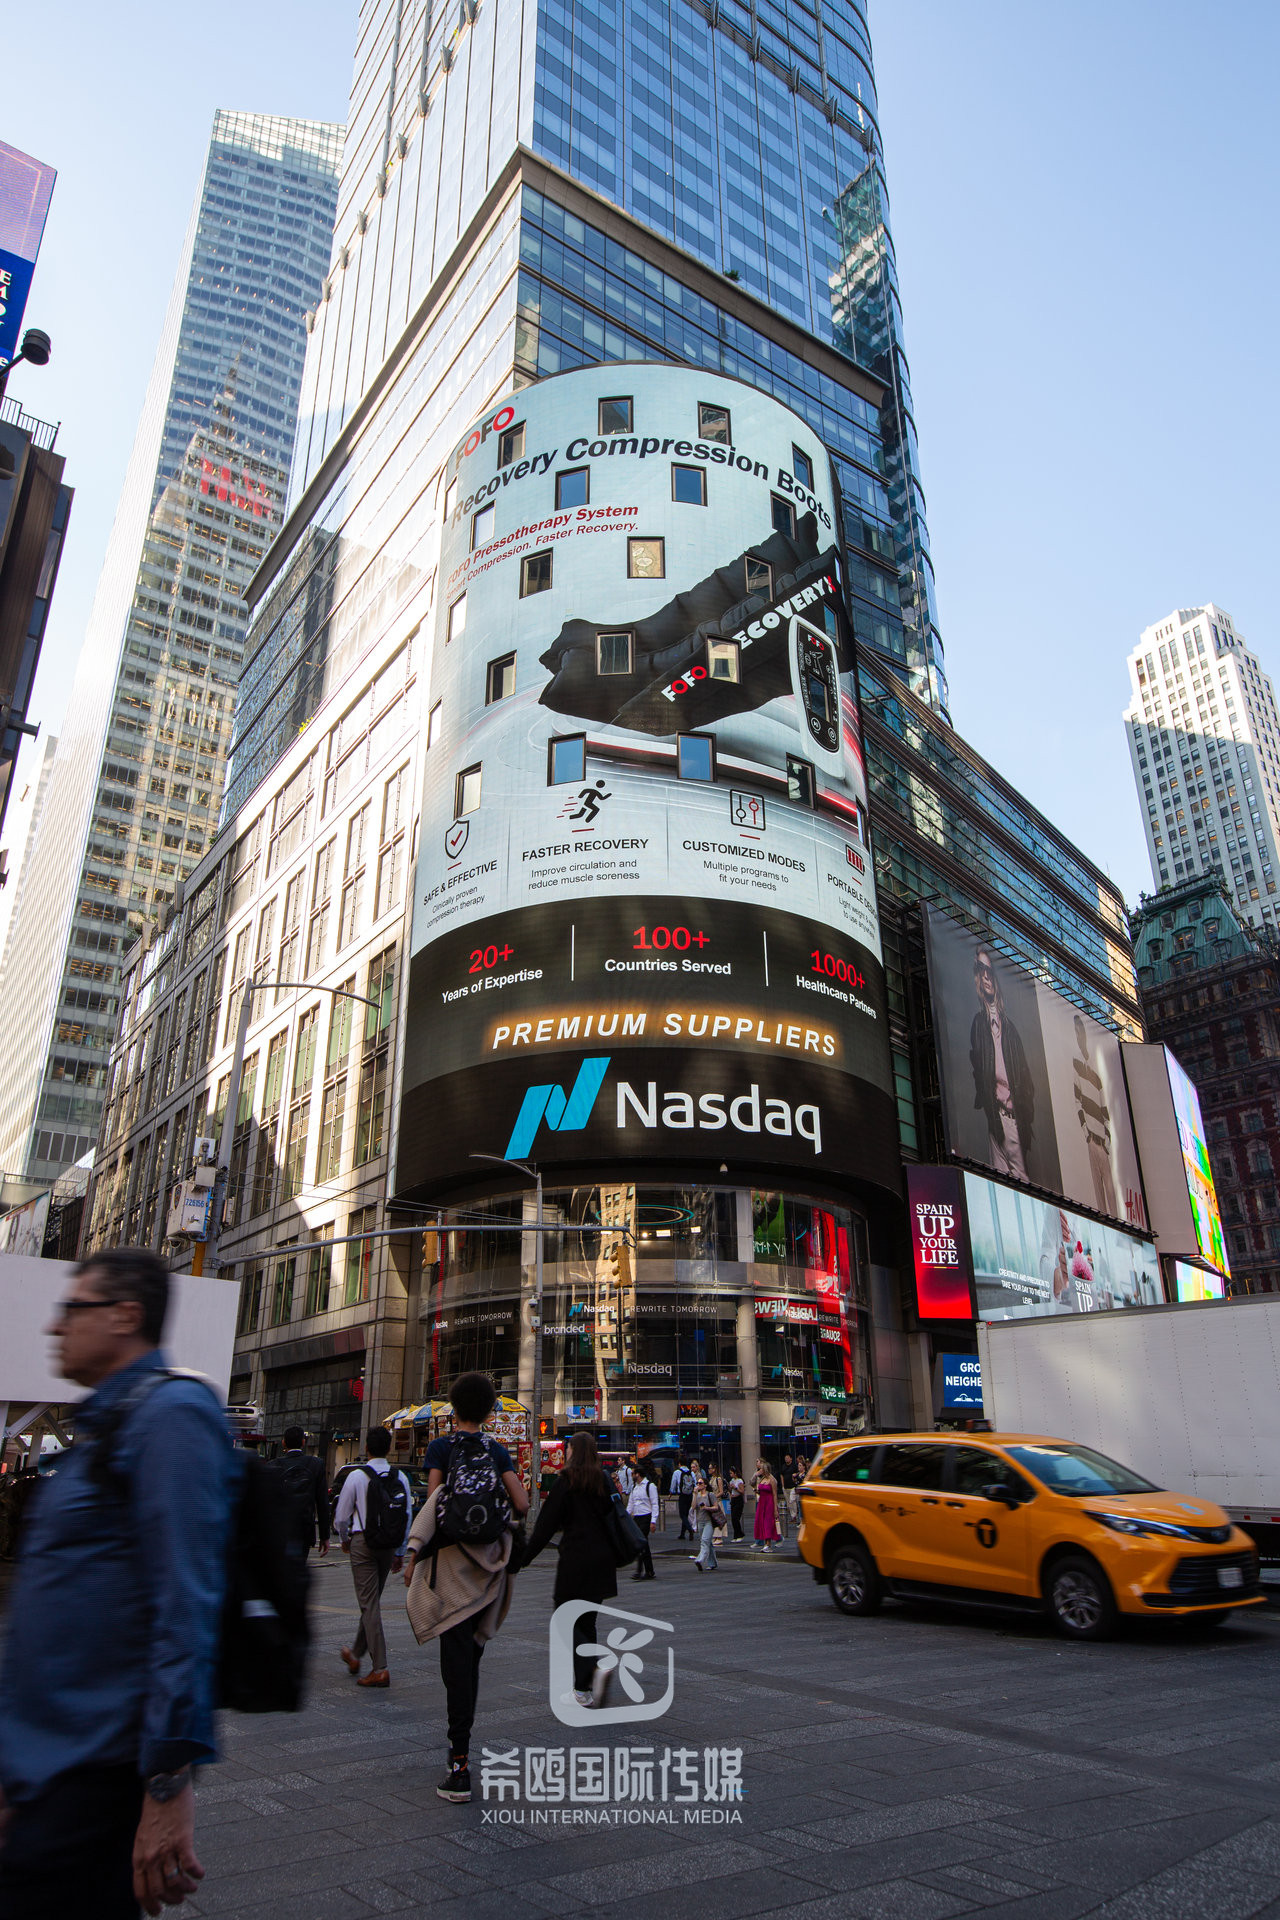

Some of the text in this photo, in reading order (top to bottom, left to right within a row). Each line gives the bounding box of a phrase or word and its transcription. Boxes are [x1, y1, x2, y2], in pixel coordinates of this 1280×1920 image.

[456, 406, 515, 470] FOFO
[451, 437, 832, 530] Recovery Compression Boots
[447, 505, 639, 588] FOFO Pressotherapy System
[467, 541, 532, 582] Compression.
[535, 527, 573, 546] Faster
[576, 522, 639, 535] Recovery.
[807, 633, 825, 651] FOFO
[661, 665, 708, 702] FOFO
[522, 838, 649, 861] FASTER RECOVERY
[682, 840, 806, 872] CUSTOMIZED MODES
[528, 872, 640, 890] reduce muscle soreness
[531, 859, 637, 878] Improve circulation and
[703, 860, 789, 883] Multiple programs to
[423, 860, 498, 906] SAFE & EFFECTIVE
[719, 873, 777, 892] fit your needs
[827, 873, 864, 904] PORTABLE
[427, 895, 486, 929] compression therapy
[432, 886, 478, 914] Clinically proven
[632, 926, 711, 950] 100+
[469, 944, 514, 974] 20+
[604, 959, 732, 975] Countries Served
[811, 950, 866, 989] 1000+
[441, 968, 544, 1004] Years of Expertise
[796, 974, 877, 1019] Healthcare Partners
[492, 1012, 836, 1056] PREMIUM SUPPLIERS
[616, 1080, 823, 1155] Nasdaq
[915, 1203, 953, 1216] SPAIN
[1124, 1187, 1145, 1228] H&M
[917, 1214, 955, 1238] UP
[918, 1237, 958, 1249] YOUR
[920, 1249, 959, 1265] LIFE
[1075, 1280, 1092, 1294] SPAIN
[583, 1304, 718, 1315] Nasdaq REWRITE TOMORROW
[1076, 1292, 1094, 1312] UP
[477, 1311, 513, 1322] TOMORROW
[628, 1362, 673, 1377] Nasdaq
